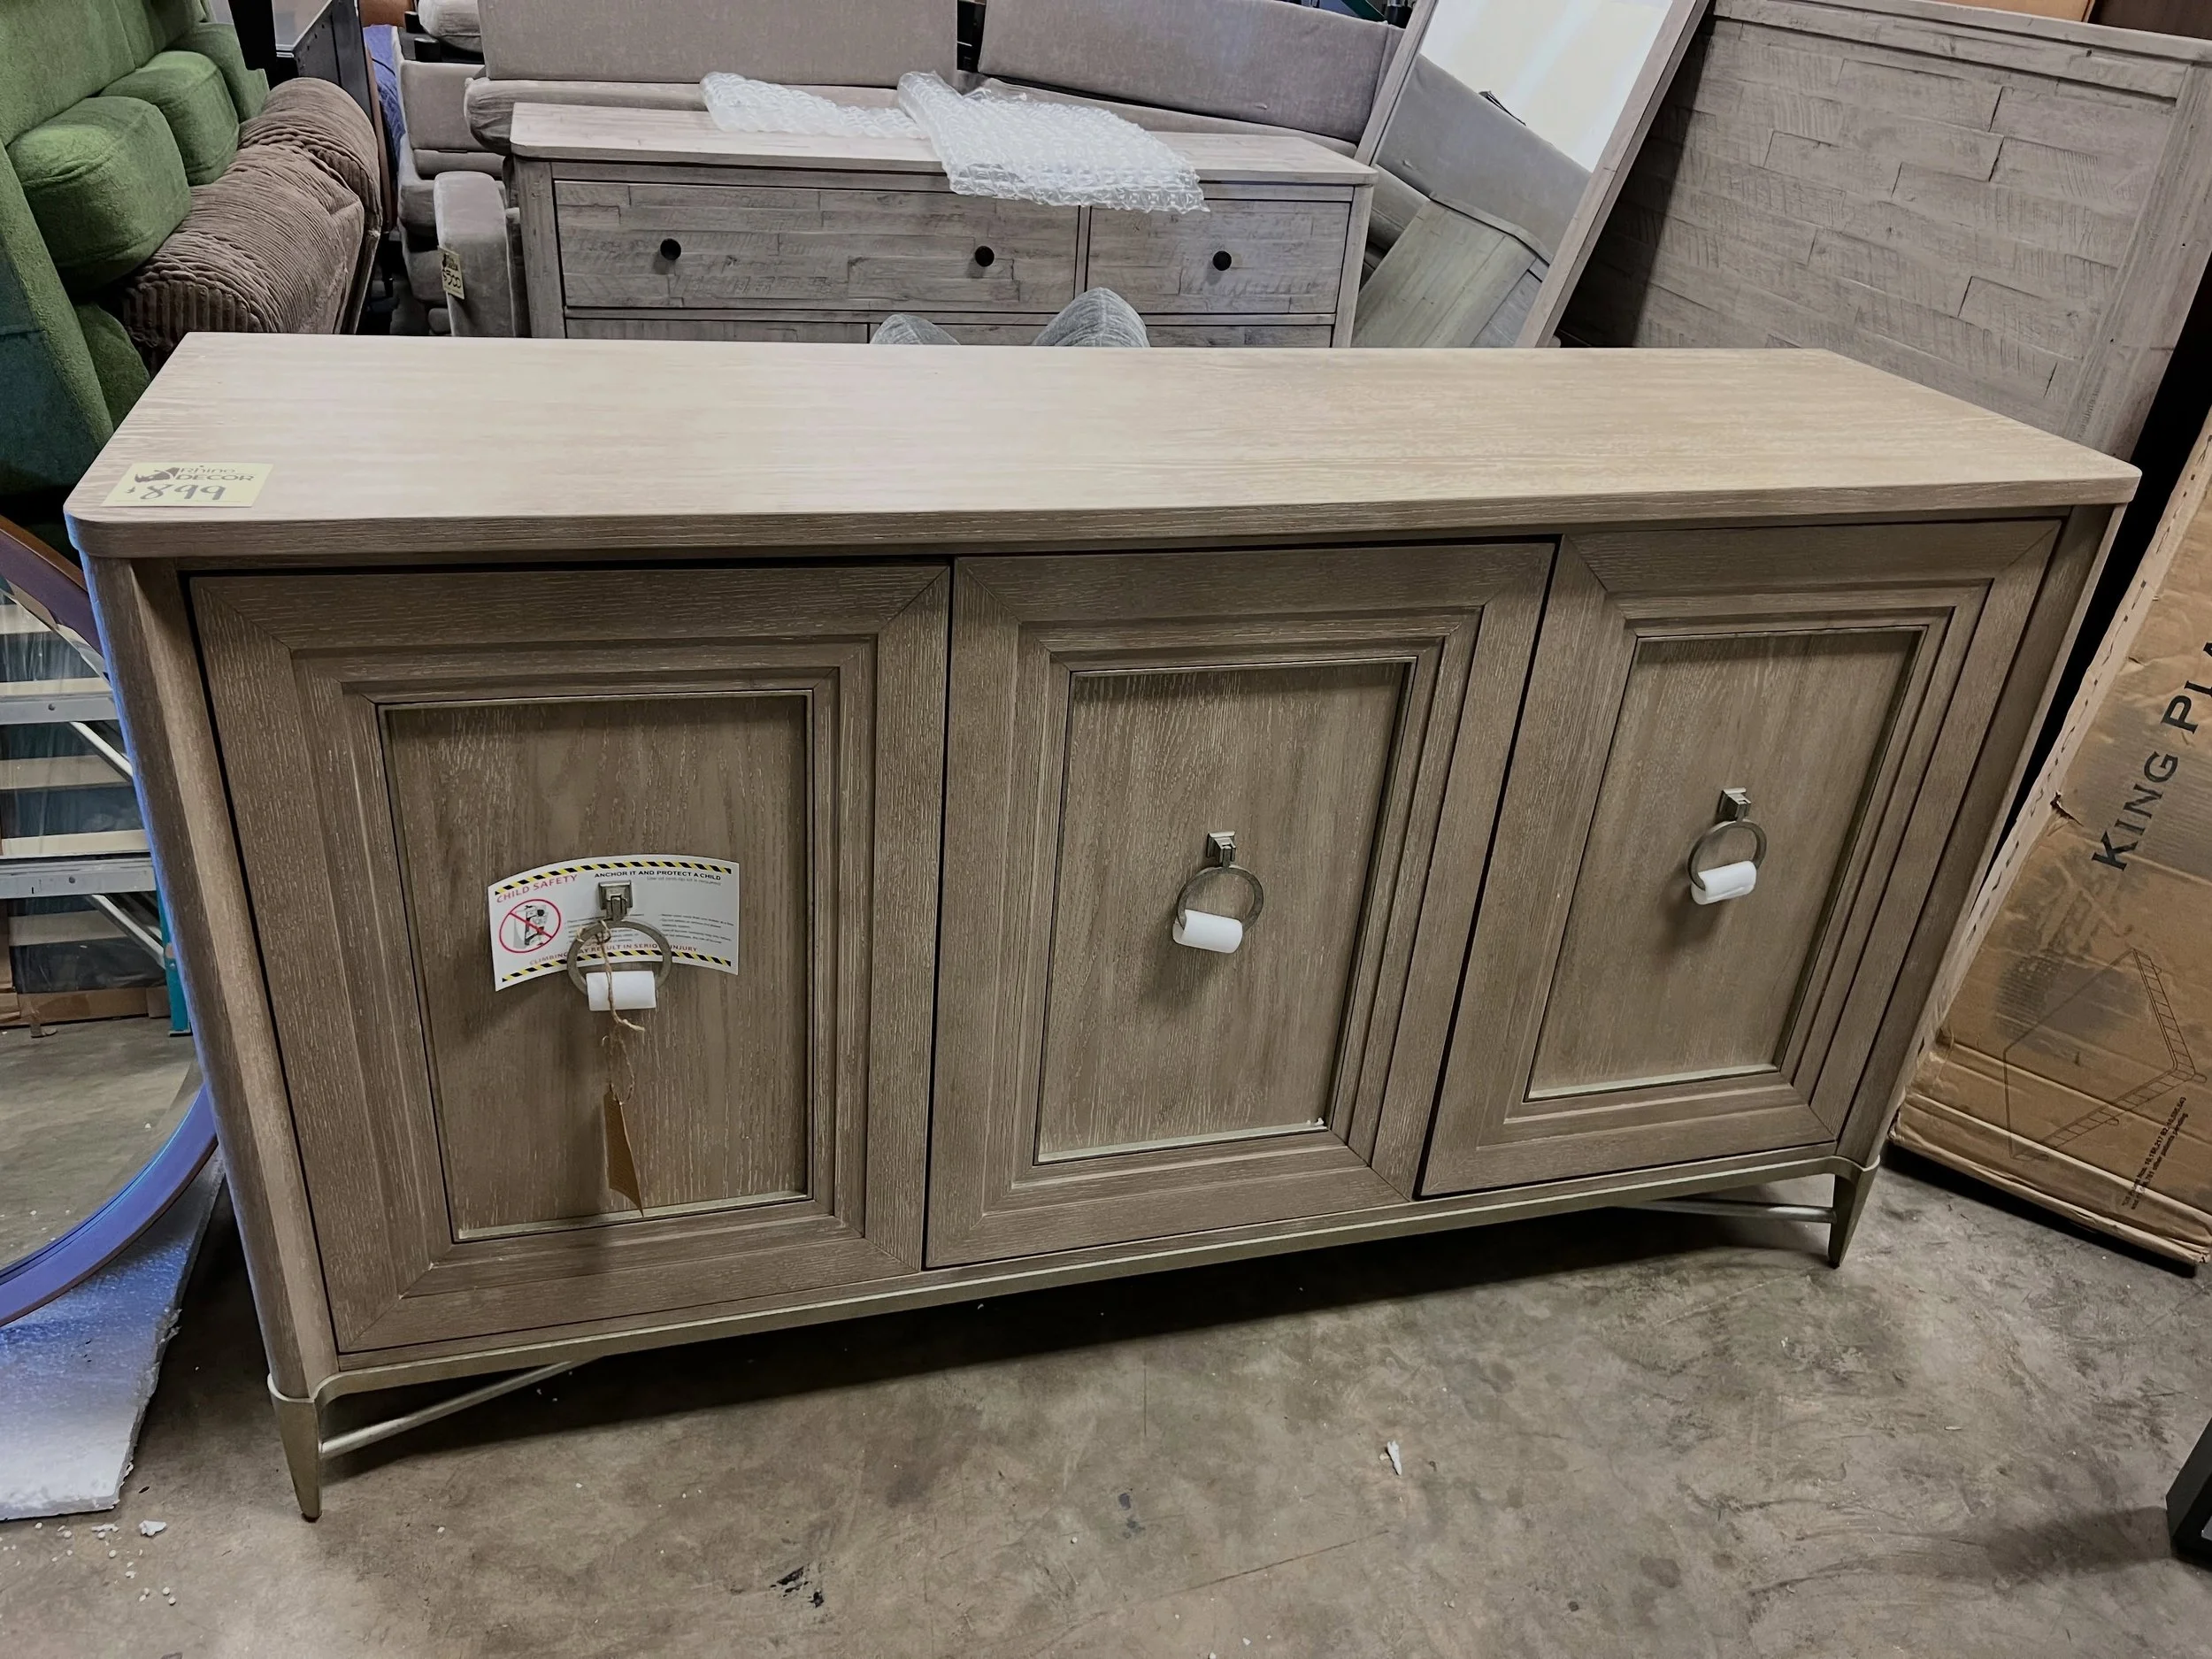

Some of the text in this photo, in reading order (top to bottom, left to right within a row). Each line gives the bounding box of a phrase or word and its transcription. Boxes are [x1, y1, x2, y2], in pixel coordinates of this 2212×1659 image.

[2092, 751, 2178, 872] KING
[496, 874, 578, 902] CHILD SAFETY
[590, 944, 620, 953] REULT
